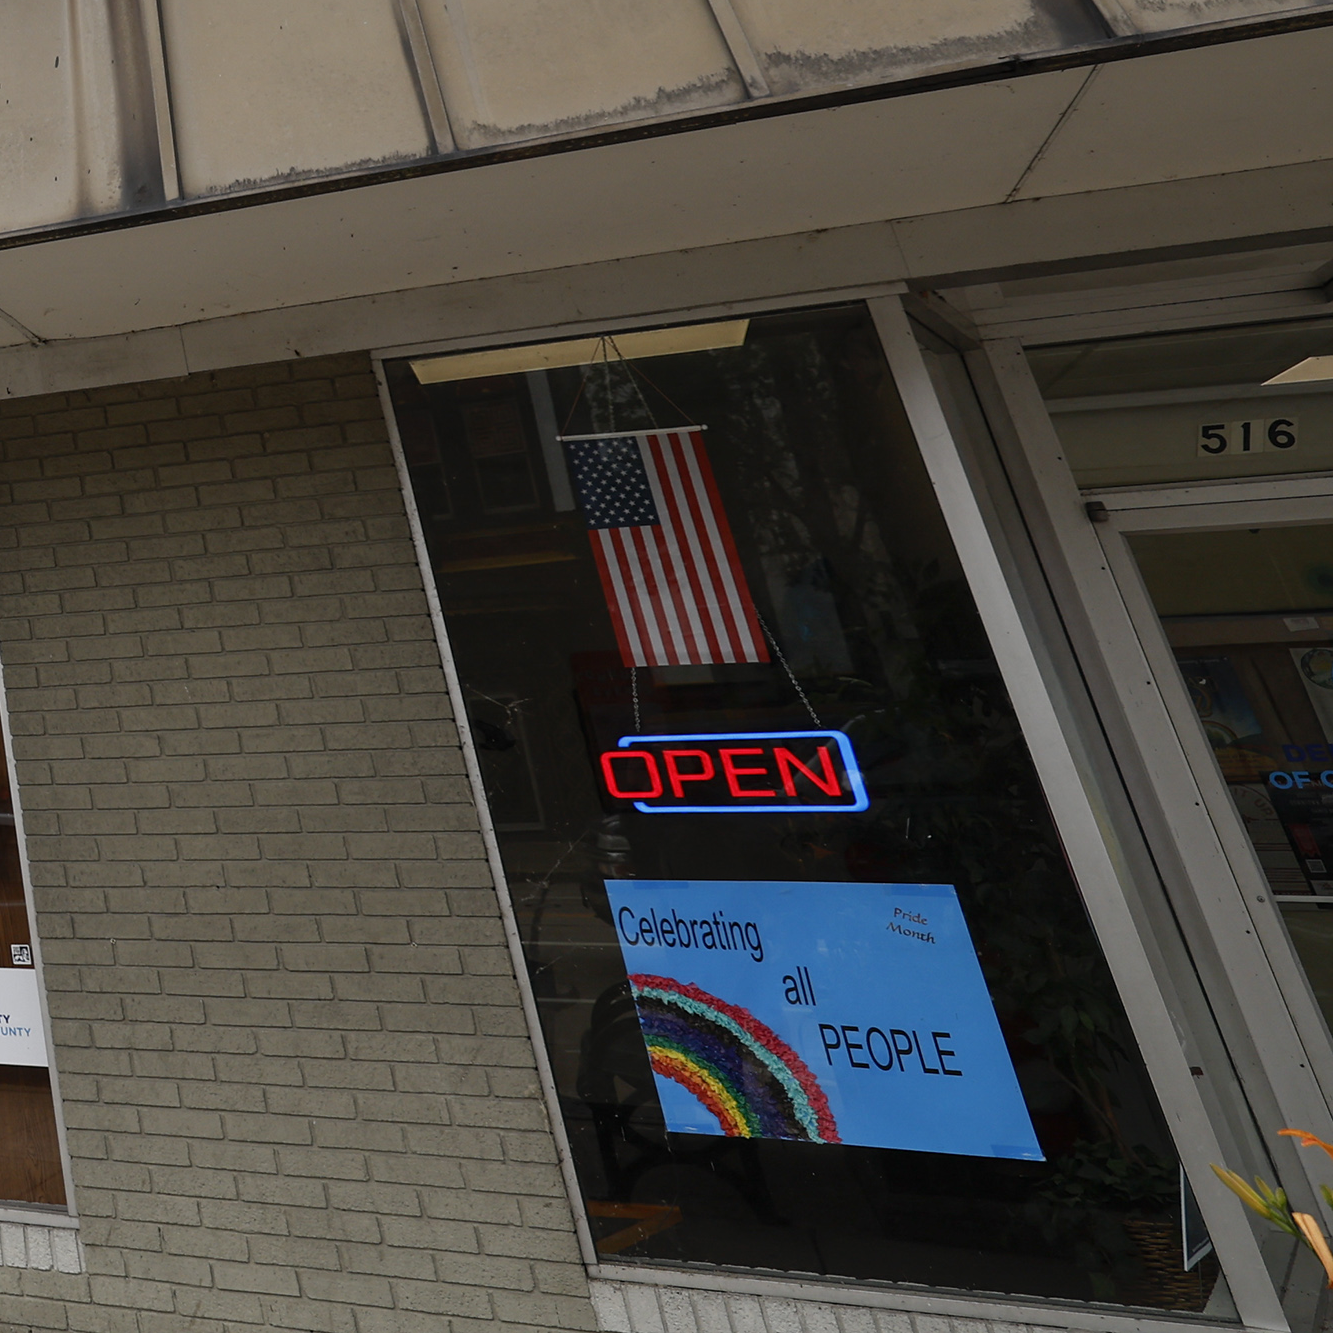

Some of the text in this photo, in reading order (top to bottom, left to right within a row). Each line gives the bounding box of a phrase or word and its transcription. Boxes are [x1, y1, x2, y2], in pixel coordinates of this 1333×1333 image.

[1200, 419, 1296, 454] 516
[600, 745, 843, 799] OPEN
[1269, 771, 1311, 790] OF
[618, 905, 764, 963] Celebrating
[886, 921, 937, 945] Month
[893, 907, 928, 926] Pride
[782, 966, 816, 1007] all
[818, 1023, 963, 1077] PEOPLE
